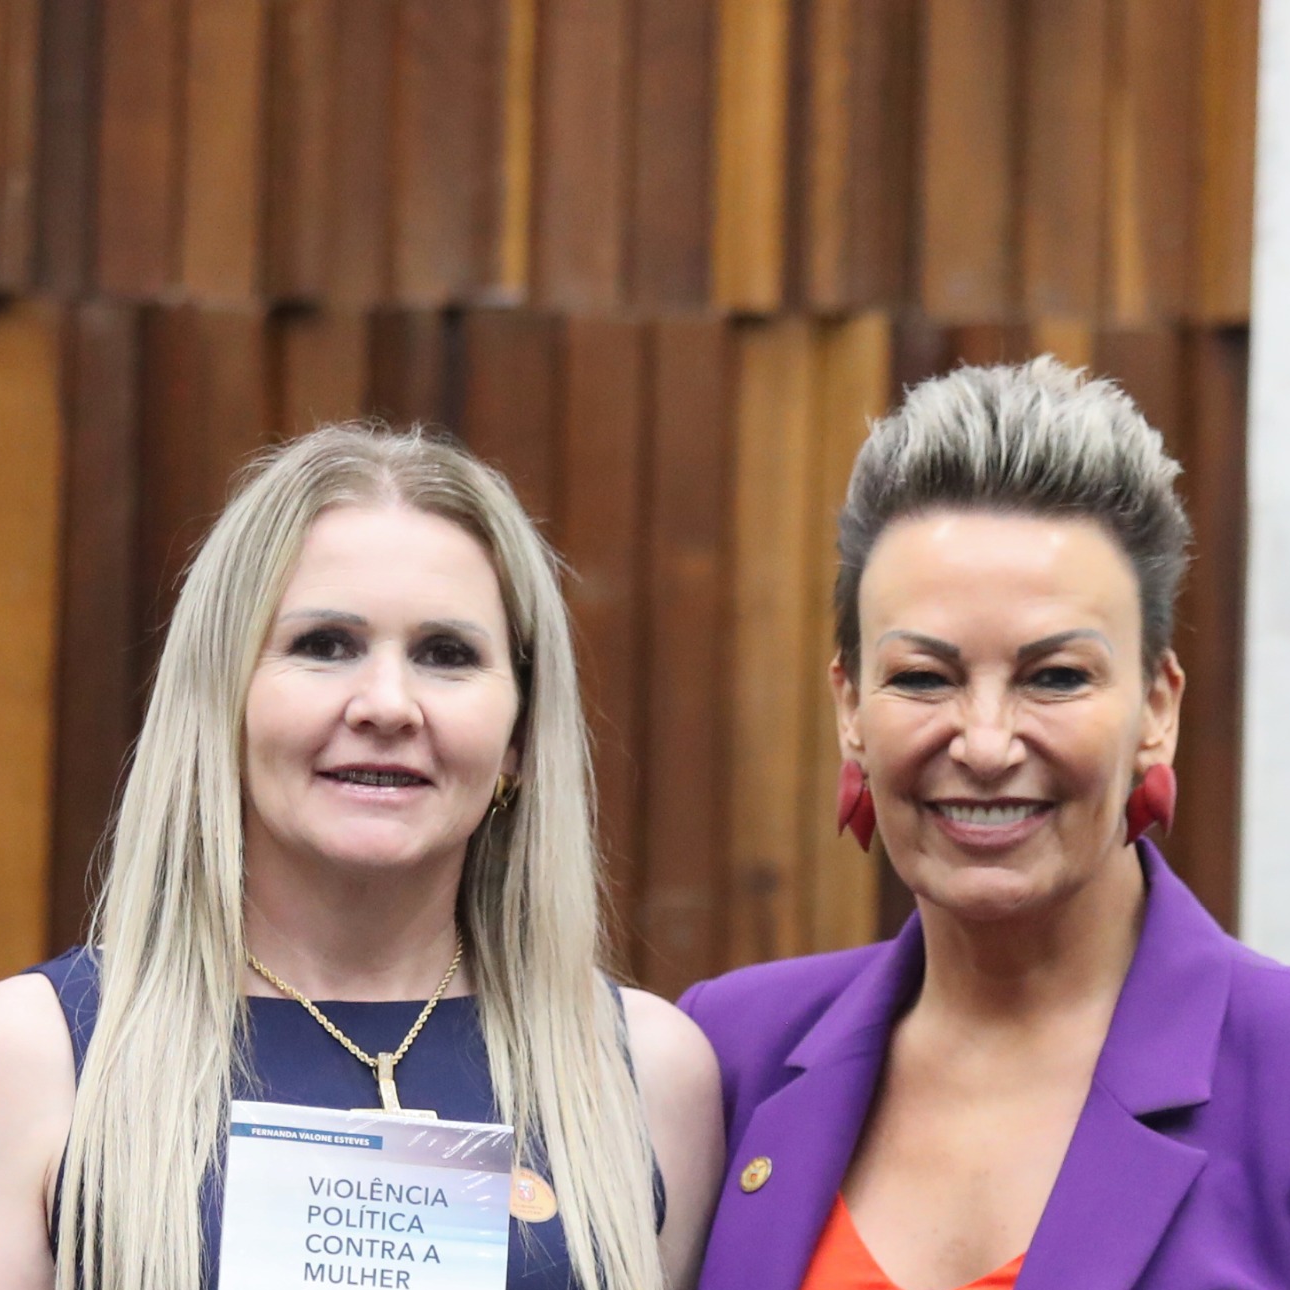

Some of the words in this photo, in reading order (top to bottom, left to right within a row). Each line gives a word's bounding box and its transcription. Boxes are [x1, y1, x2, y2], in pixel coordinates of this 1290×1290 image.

[251, 1127, 298, 1139] FERNANDA
[299, 1132, 333, 1143] VALONE
[334, 1136, 370, 1146] ESTEVES
[308, 1176, 449, 1208] VIOLÊNCIA
[307, 1204, 425, 1234] POLÍTICA
[305, 1233, 415, 1262] CONTRA
[422, 1244, 441, 1264] A
[303, 1262, 411, 1290] MULHER
